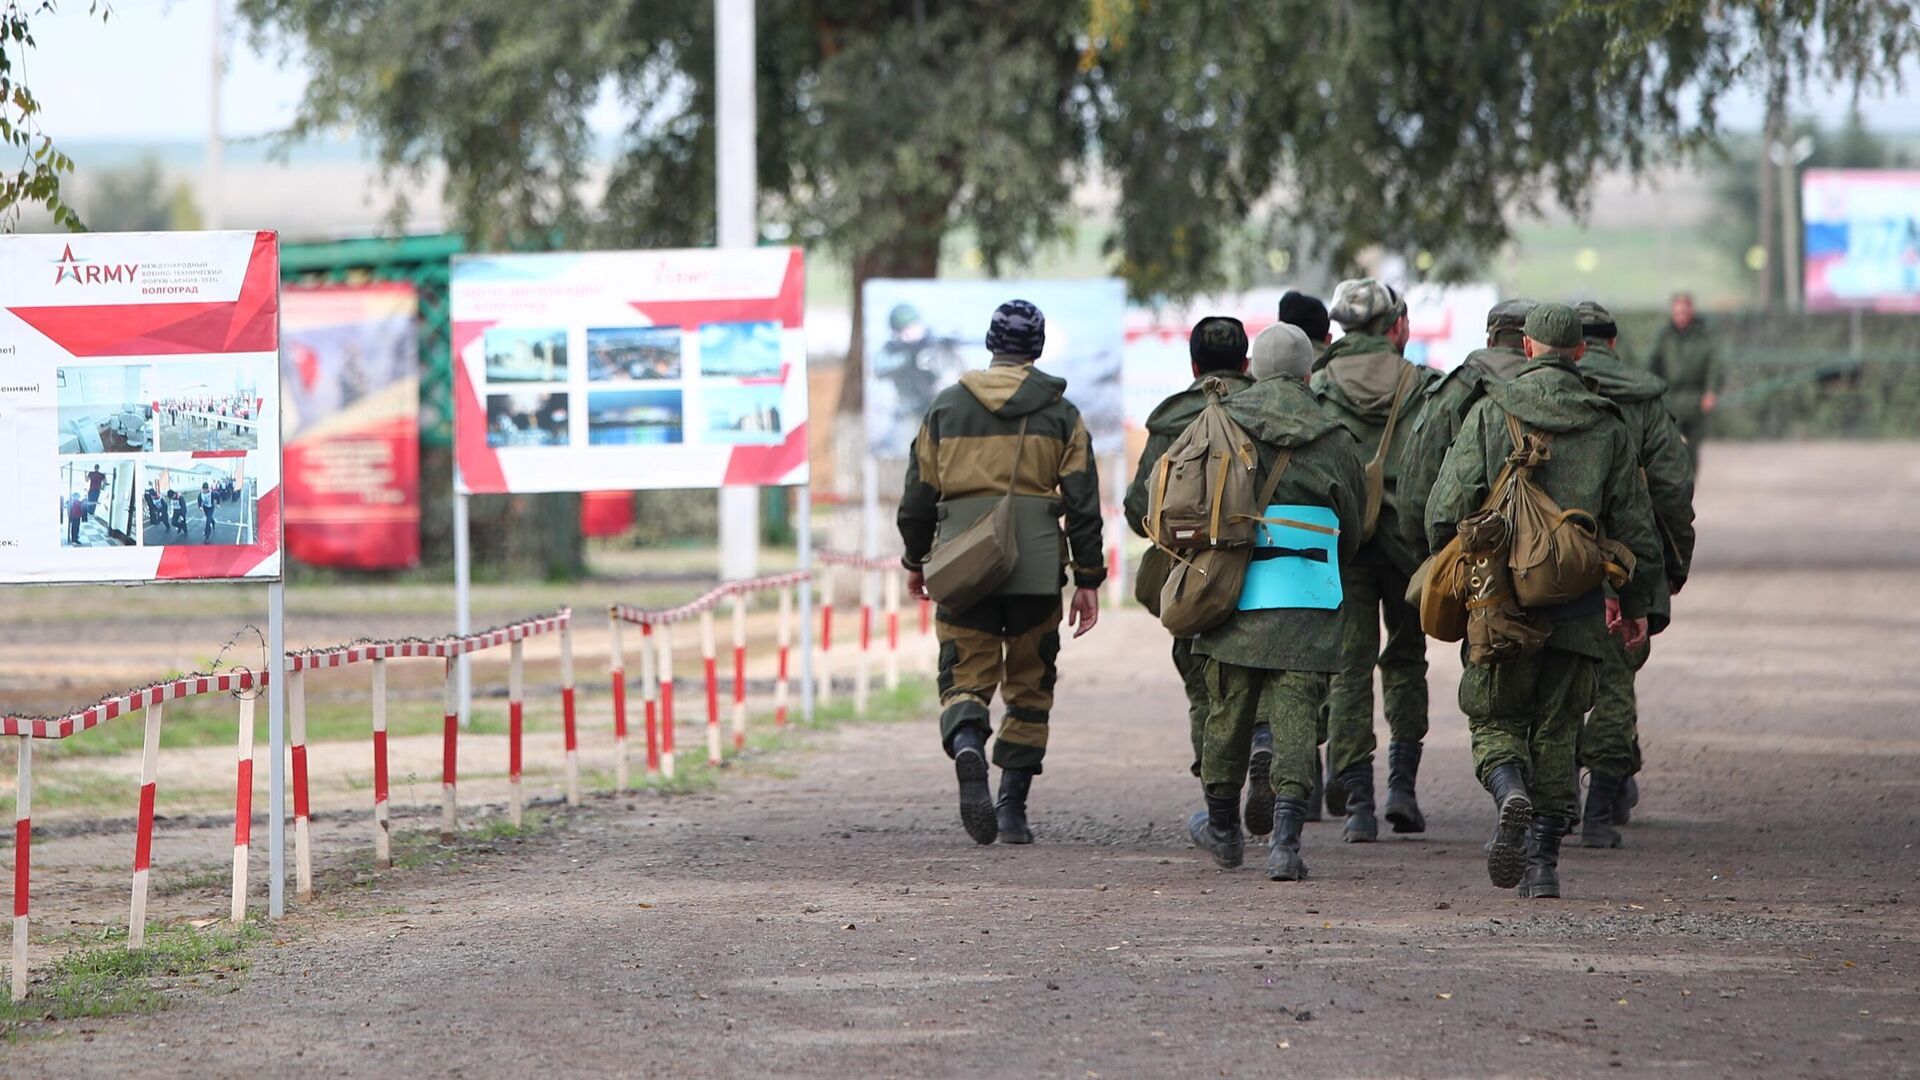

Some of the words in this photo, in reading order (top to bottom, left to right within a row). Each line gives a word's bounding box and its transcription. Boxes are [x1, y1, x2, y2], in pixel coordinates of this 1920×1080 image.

[55, 242, 138, 285] ARMY
[141, 261, 208, 270] МЕЖДУНАРОДНЫЙ
[142, 278, 169, 286] ФОРУМ
[142, 286, 199, 295] ВОЛГОГРАД
